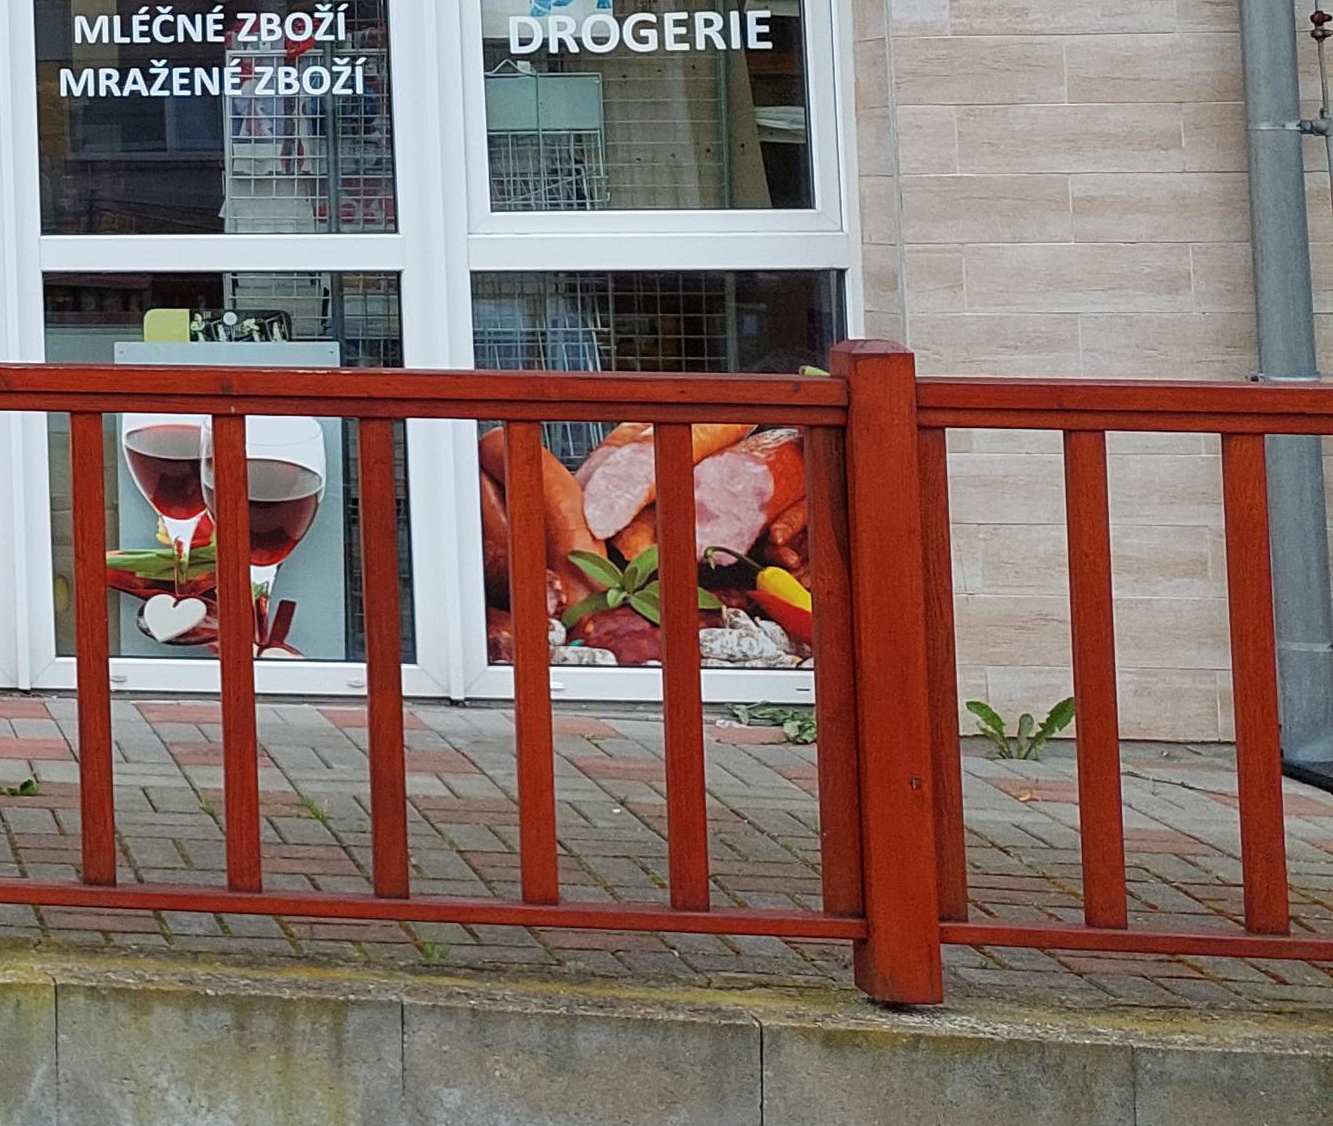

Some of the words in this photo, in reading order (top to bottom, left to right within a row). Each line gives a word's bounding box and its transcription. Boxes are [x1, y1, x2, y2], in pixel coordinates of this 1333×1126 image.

[74, 5, 226, 45] MLÉČNÉ
[236, 3, 350, 43] ZBOŽÍ
[508, 9, 773, 55] DROGERIE
[59, 59, 243, 98] MRAŽENÉ
[253, 57, 367, 96] ZBOŽÍ
